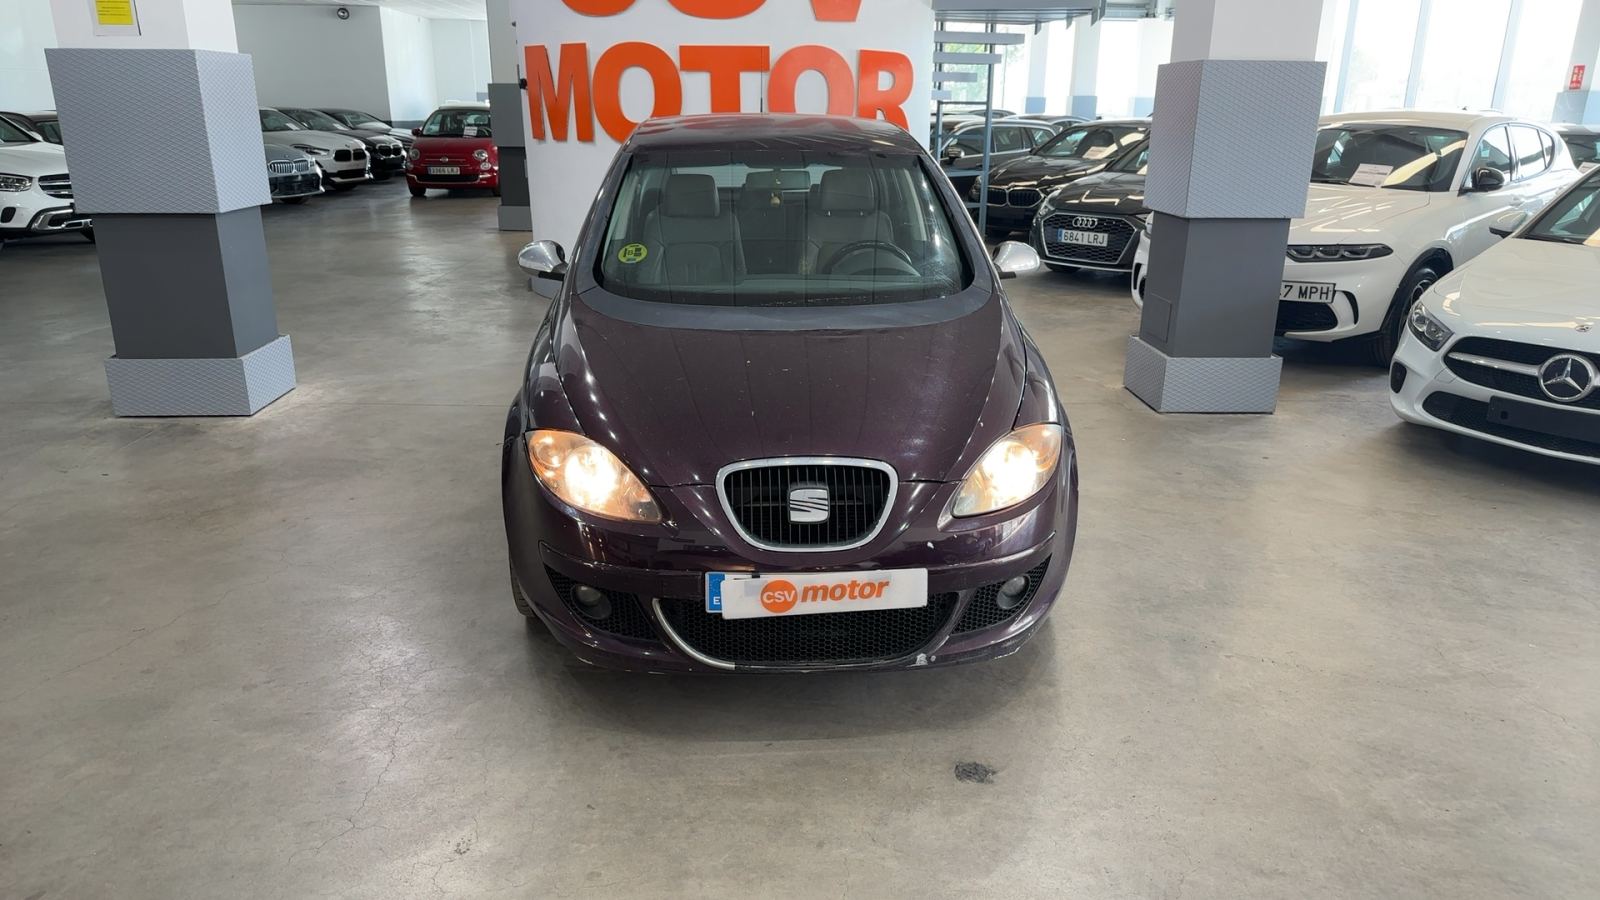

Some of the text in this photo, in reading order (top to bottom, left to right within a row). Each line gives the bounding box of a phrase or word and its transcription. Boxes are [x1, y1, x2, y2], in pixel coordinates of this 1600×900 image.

[524, 41, 914, 143] MOTOR
[1063, 231, 1105, 245] 6841 LRJ
[1279, 284, 1330, 300] 7 MPH
[762, 580, 890, 604] CSV motor
[713, 596, 721, 605] E
